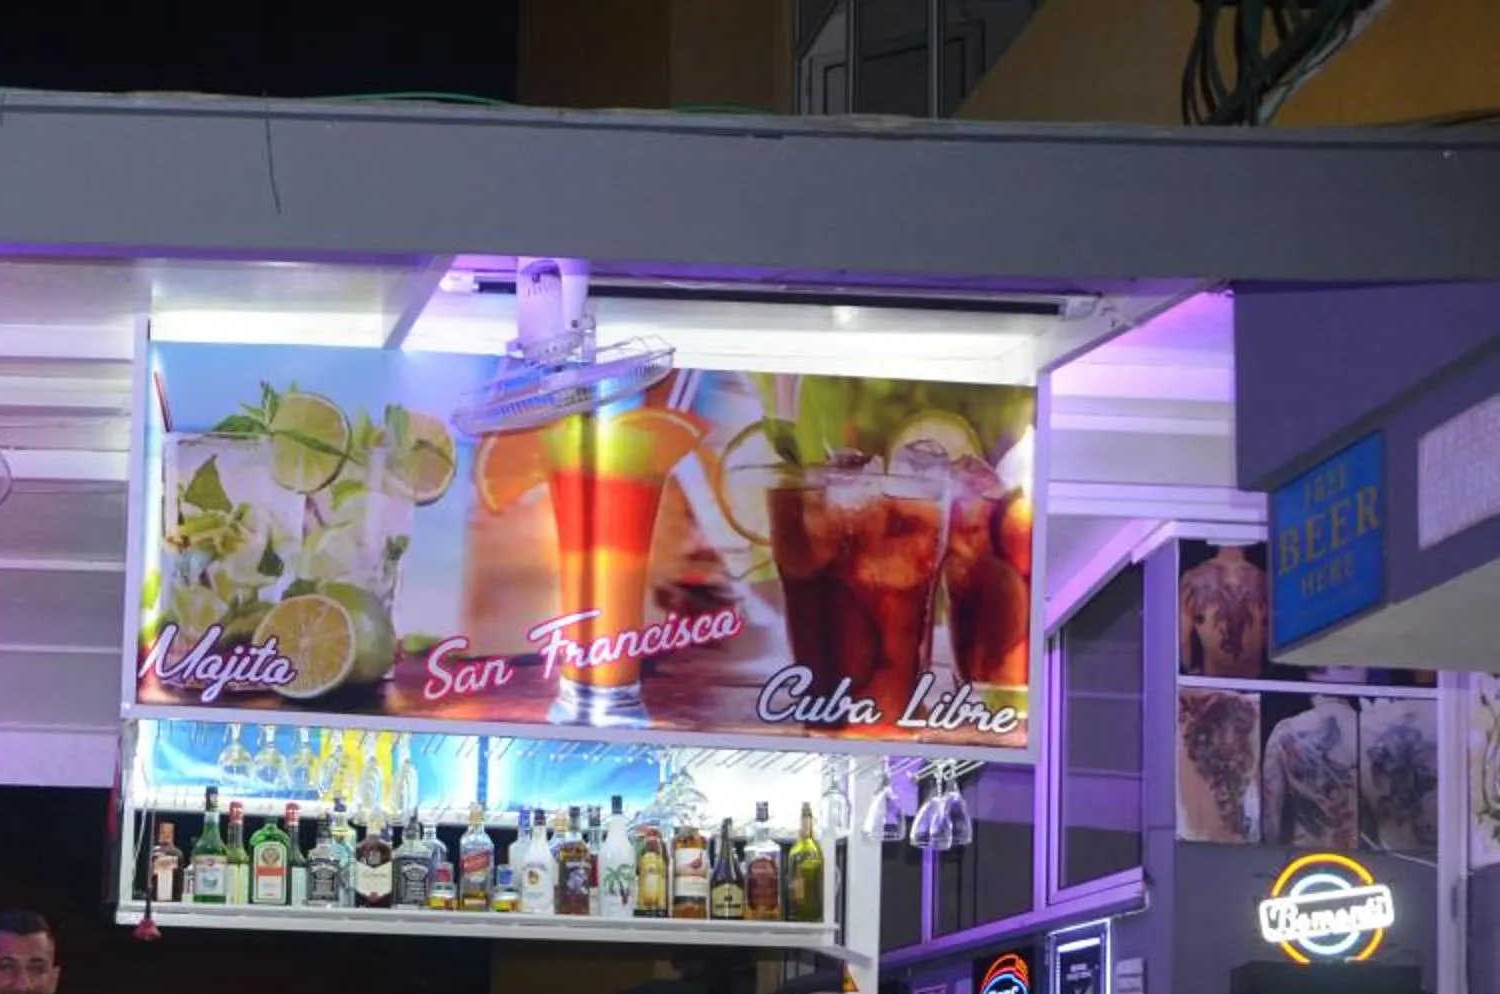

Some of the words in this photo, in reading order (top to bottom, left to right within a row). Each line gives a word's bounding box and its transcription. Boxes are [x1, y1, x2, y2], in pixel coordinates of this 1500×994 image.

[1279, 485, 1380, 577] BEER
[138, 622, 296, 703] Mojito
[424, 636, 513, 699] San
[529, 610, 740, 679] Francisco
[757, 664, 882, 724] Cuba
[897, 672, 1020, 734] Libre
